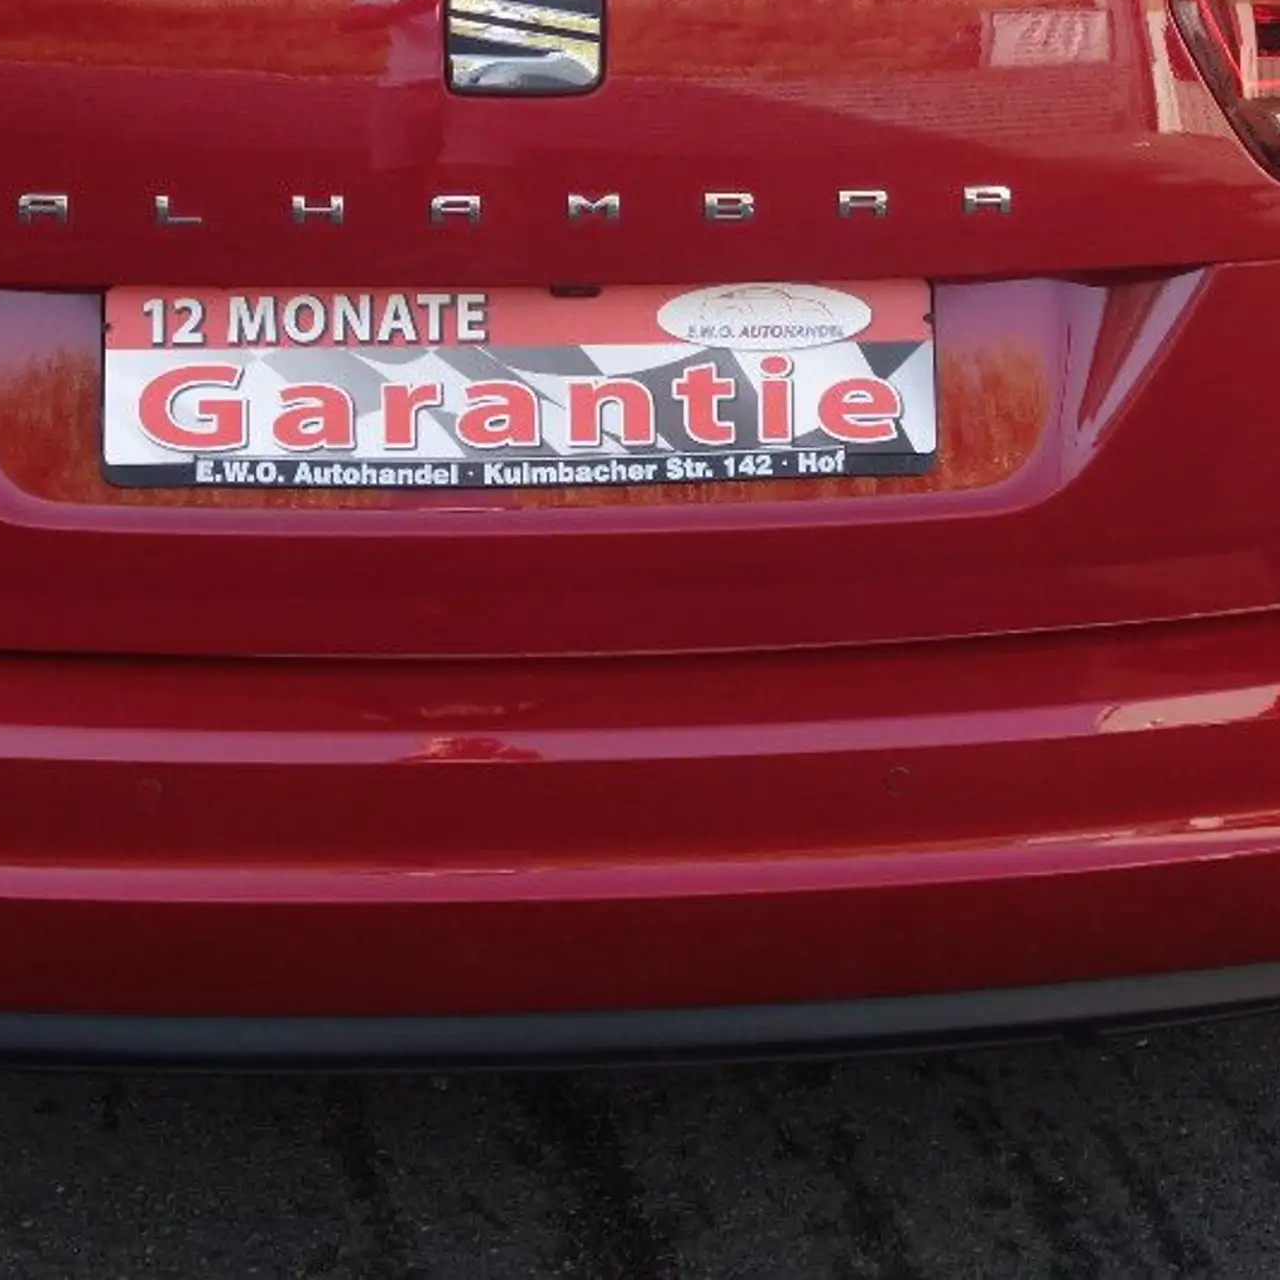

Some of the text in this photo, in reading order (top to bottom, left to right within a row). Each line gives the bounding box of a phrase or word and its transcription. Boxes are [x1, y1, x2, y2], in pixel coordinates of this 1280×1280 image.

[19, 185, 1012, 222] ALHAMBRA
[143, 293, 490, 345] 12 MONATE
[136, 354, 902, 452] Garantie
[196, 450, 845, 485] E.W.O. Autohandel Kulmbacher Str. 142 Hof
